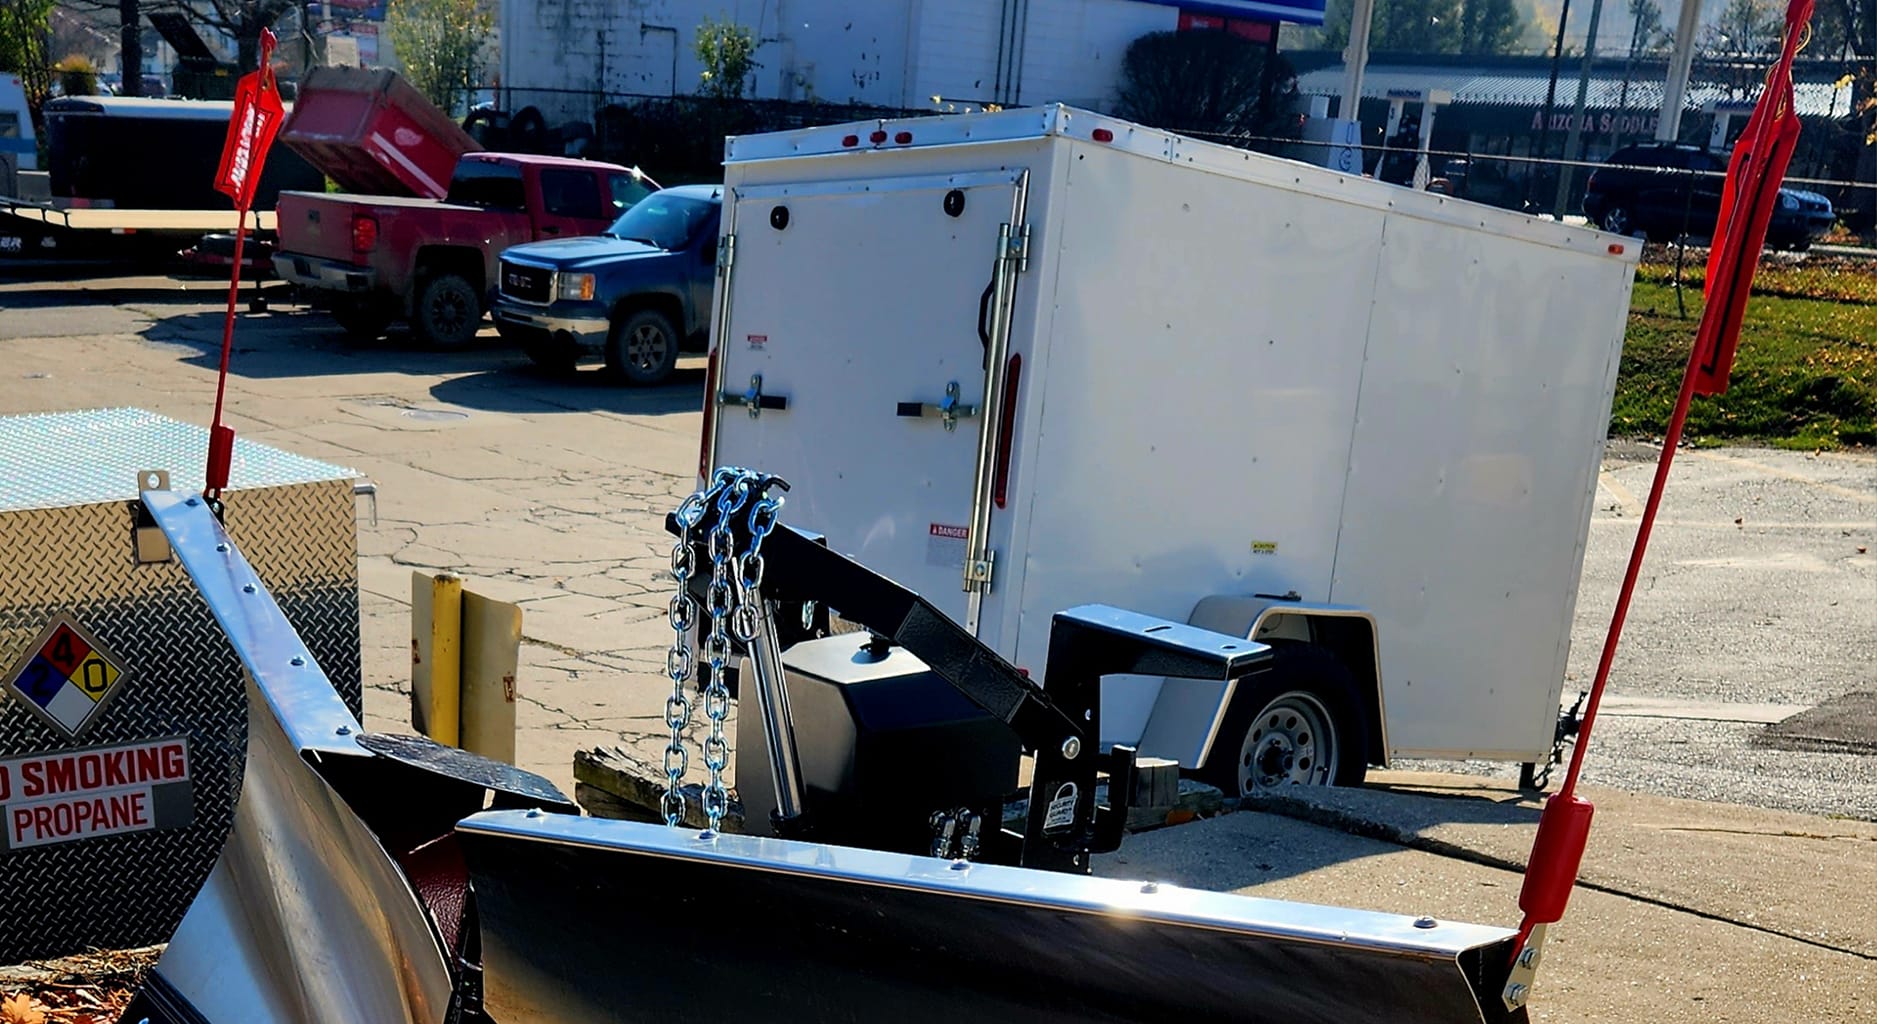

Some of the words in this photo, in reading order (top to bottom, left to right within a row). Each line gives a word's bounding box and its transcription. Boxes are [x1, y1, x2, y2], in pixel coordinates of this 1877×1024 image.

[1531, 111, 1595, 133] AIZOA
[53, 633, 75, 667] 4
[31, 663, 50, 696] 2
[83, 658, 108, 693] 0
[21, 744, 186, 798] SMOKING
[14, 793, 148, 842] PROPANE
